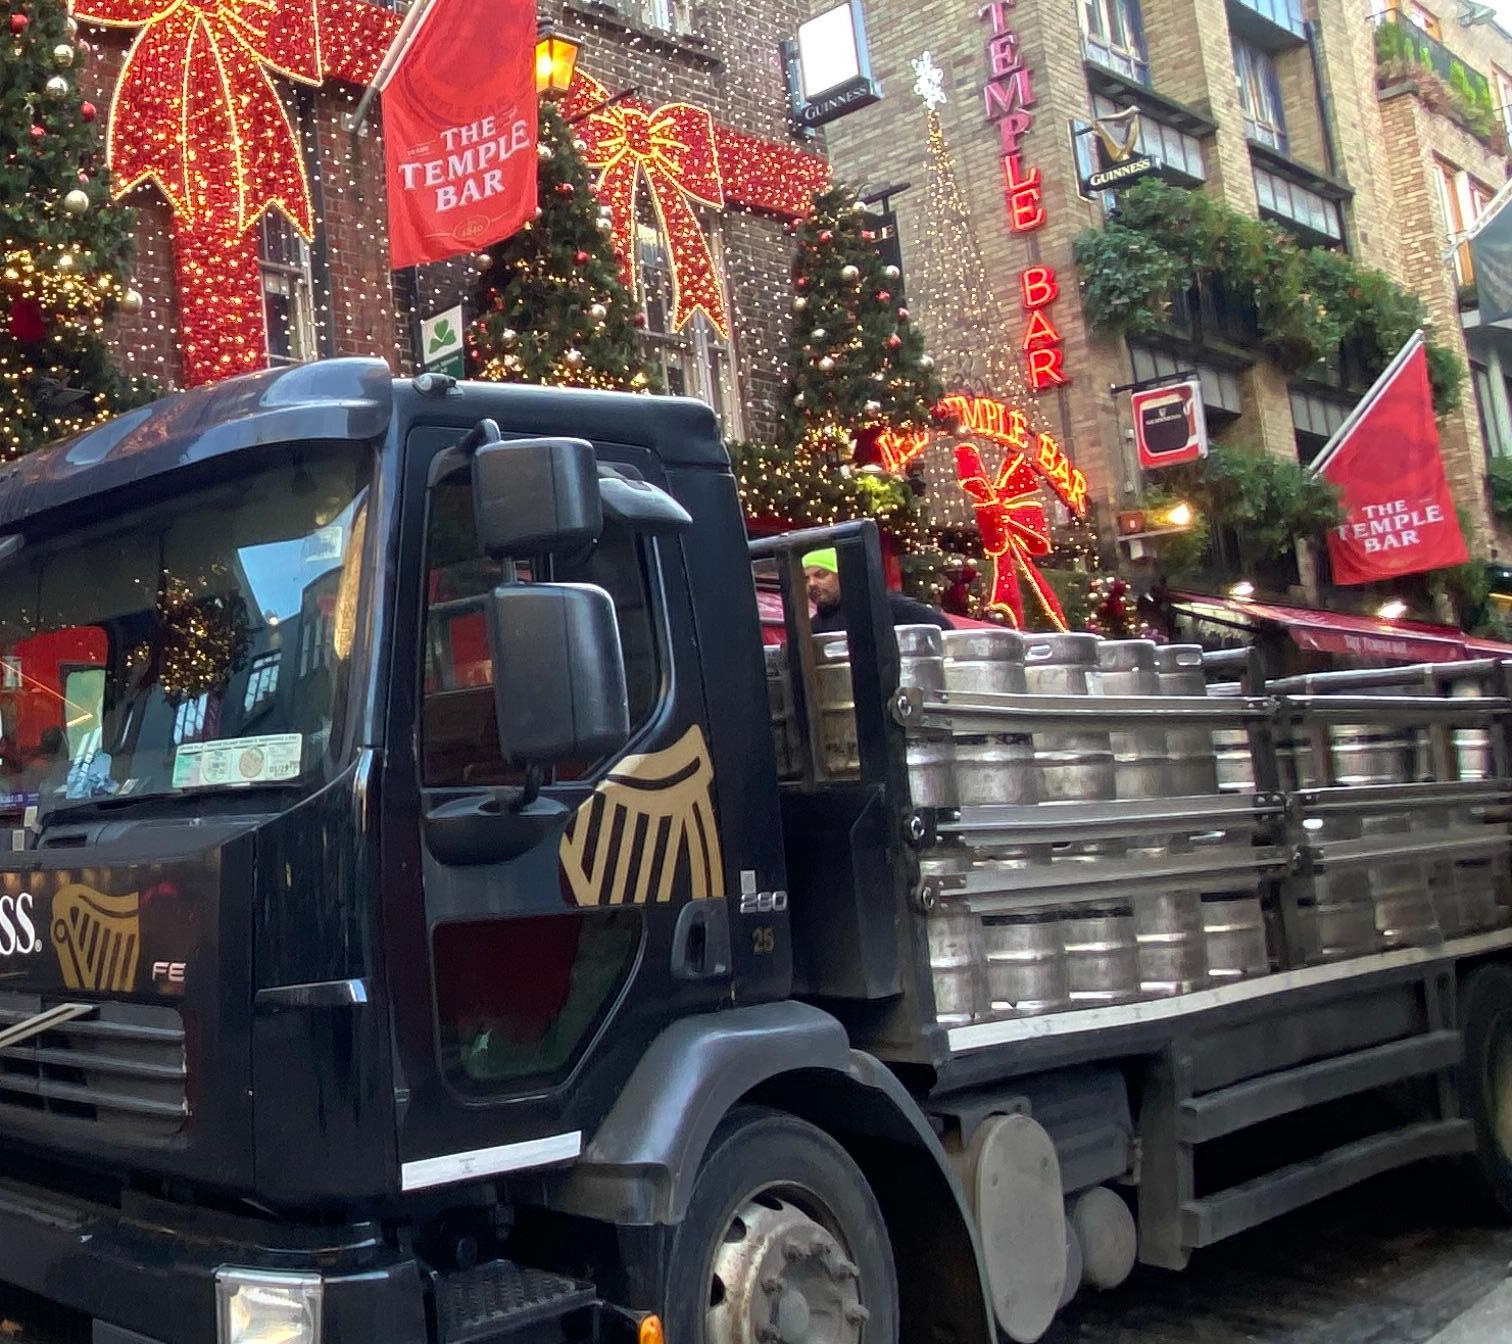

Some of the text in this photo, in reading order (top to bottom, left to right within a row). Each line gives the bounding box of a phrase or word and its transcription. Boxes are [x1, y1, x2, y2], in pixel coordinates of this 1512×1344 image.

[804, 86, 868, 121] GUINNESS
[440, 115, 497, 152] THE
[398, 119, 531, 191] TEMPLE
[1090, 159, 1151, 187] GUINNESS
[435, 168, 506, 213] BAR
[1019, 265, 1069, 393] BAR
[1037, 430, 1089, 519] BAR
[1336, 504, 1445, 541] TEMPLE
[1361, 499, 1409, 519] THE
[1364, 529, 1421, 553] BAR
[740, 890, 788, 914] 280
[152, 960, 187, 983] FE
